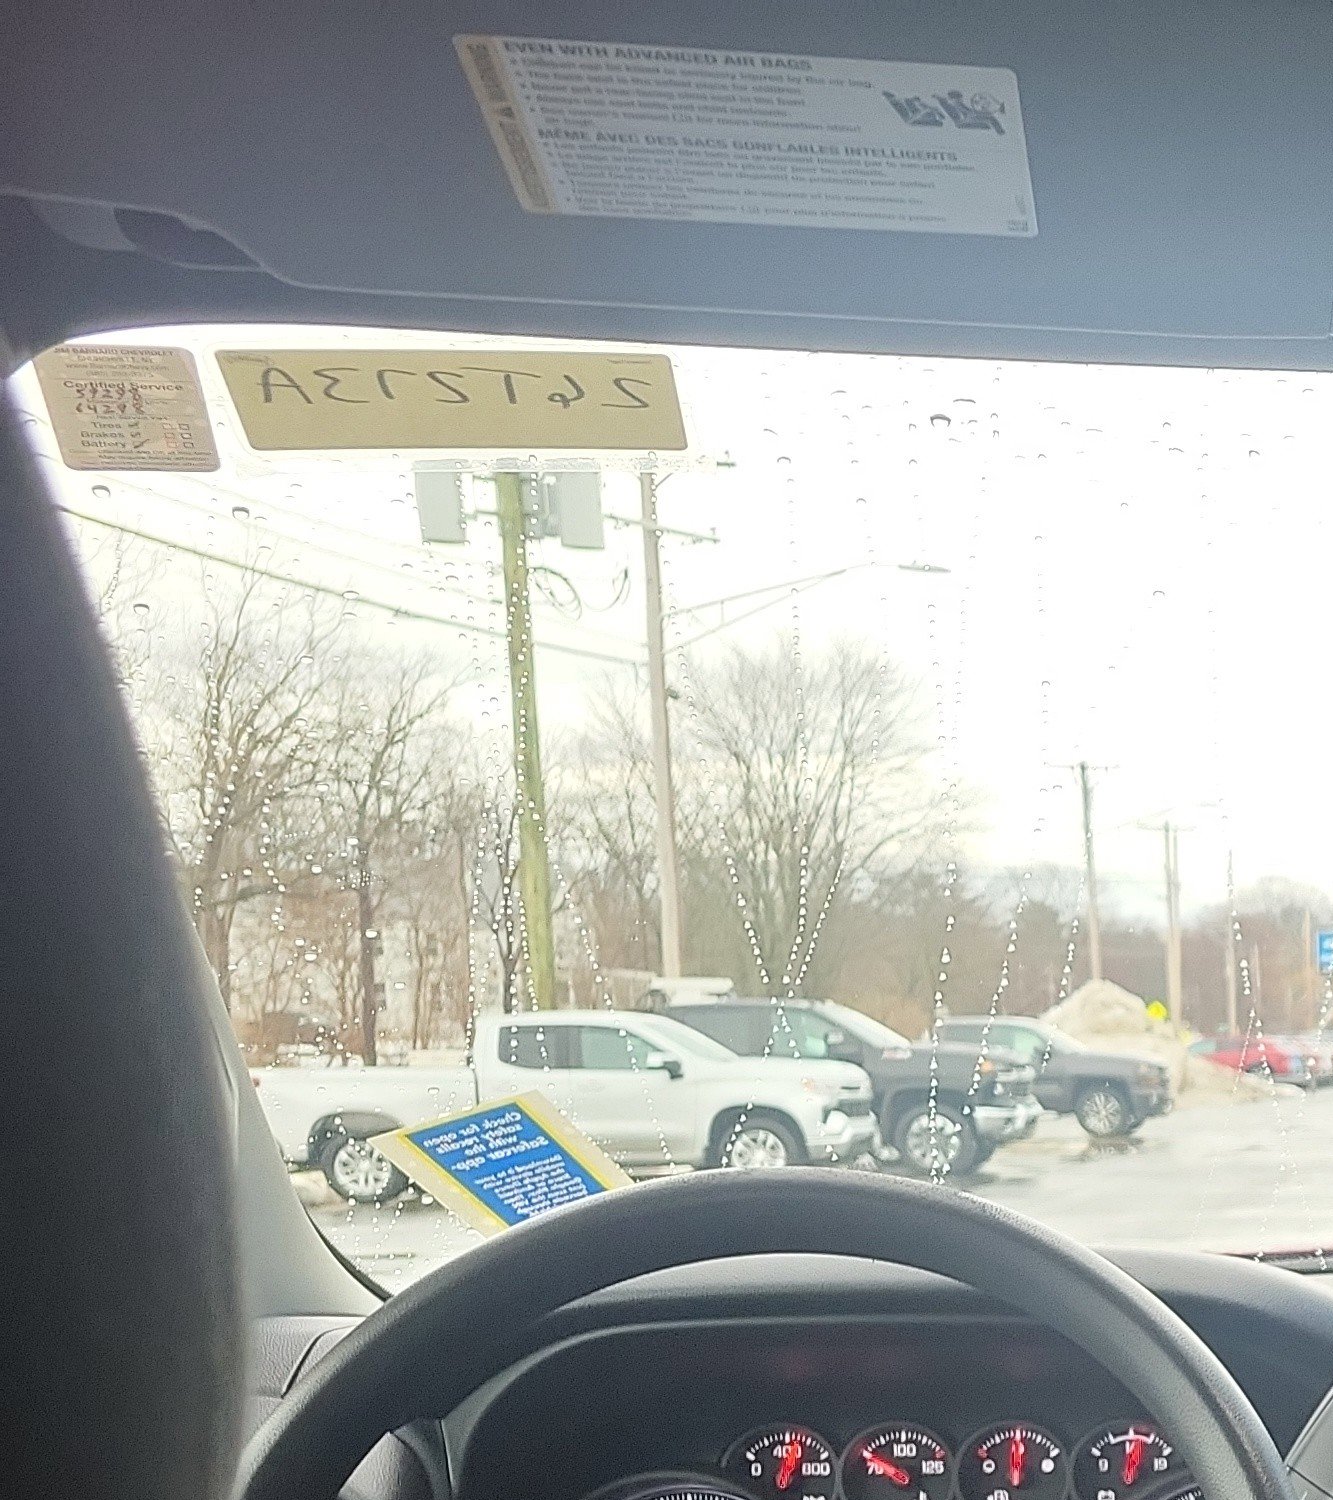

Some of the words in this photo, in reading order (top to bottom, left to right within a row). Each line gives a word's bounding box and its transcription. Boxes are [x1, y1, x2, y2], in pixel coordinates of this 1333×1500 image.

[724, 54, 756, 67] AIR
[760, 56, 813, 71] BAGS
[120, 348, 174, 356] CHEVROLET
[63, 380, 125, 390] Certified
[130, 382, 183, 391] Service
[90, 421, 122, 429] Tires
[80, 431, 125, 439] Brakes
[81, 440, 127, 449] Battery
[893, 1443, 917, 1458] 100
[751, 1462, 763, 1476] 0
[922, 1460, 945, 1474] 125
